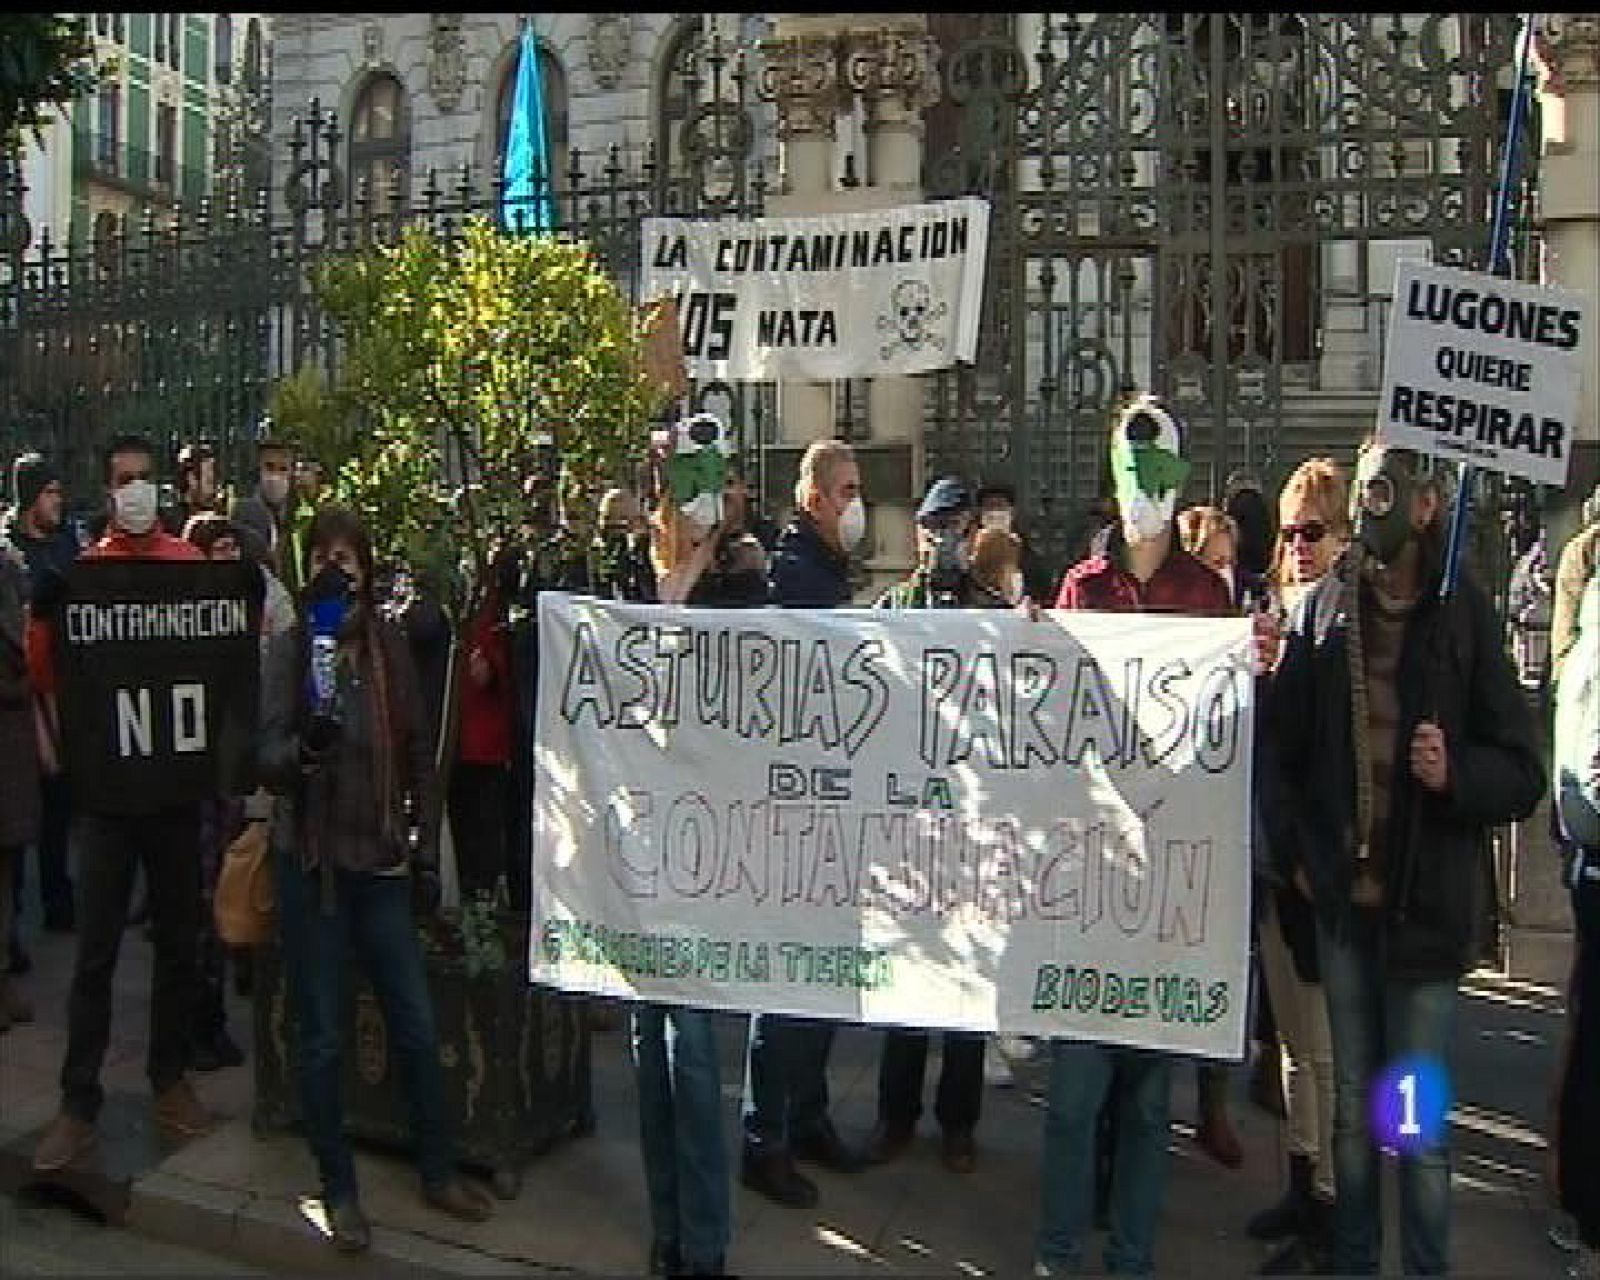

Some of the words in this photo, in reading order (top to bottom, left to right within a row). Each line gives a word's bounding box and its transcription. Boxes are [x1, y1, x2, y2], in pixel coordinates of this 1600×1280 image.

[653, 235, 688, 268] LA
[714, 217, 968, 272] CONTAMINACION
[677, 292, 737, 361] OS
[1406, 279, 1582, 350] LUGONES
[1436, 346, 1533, 392] QUIERE
[1390, 386, 1566, 459] RESPIRAR
[67, 599, 247, 641] CONTAMINACION
[116, 684, 208, 757] NO
[560, 621, 890, 759] ASTURIAS
[920, 647, 1240, 773] PARAISO
[768, 763, 852, 800] DE
[886, 772, 953, 809] LA
